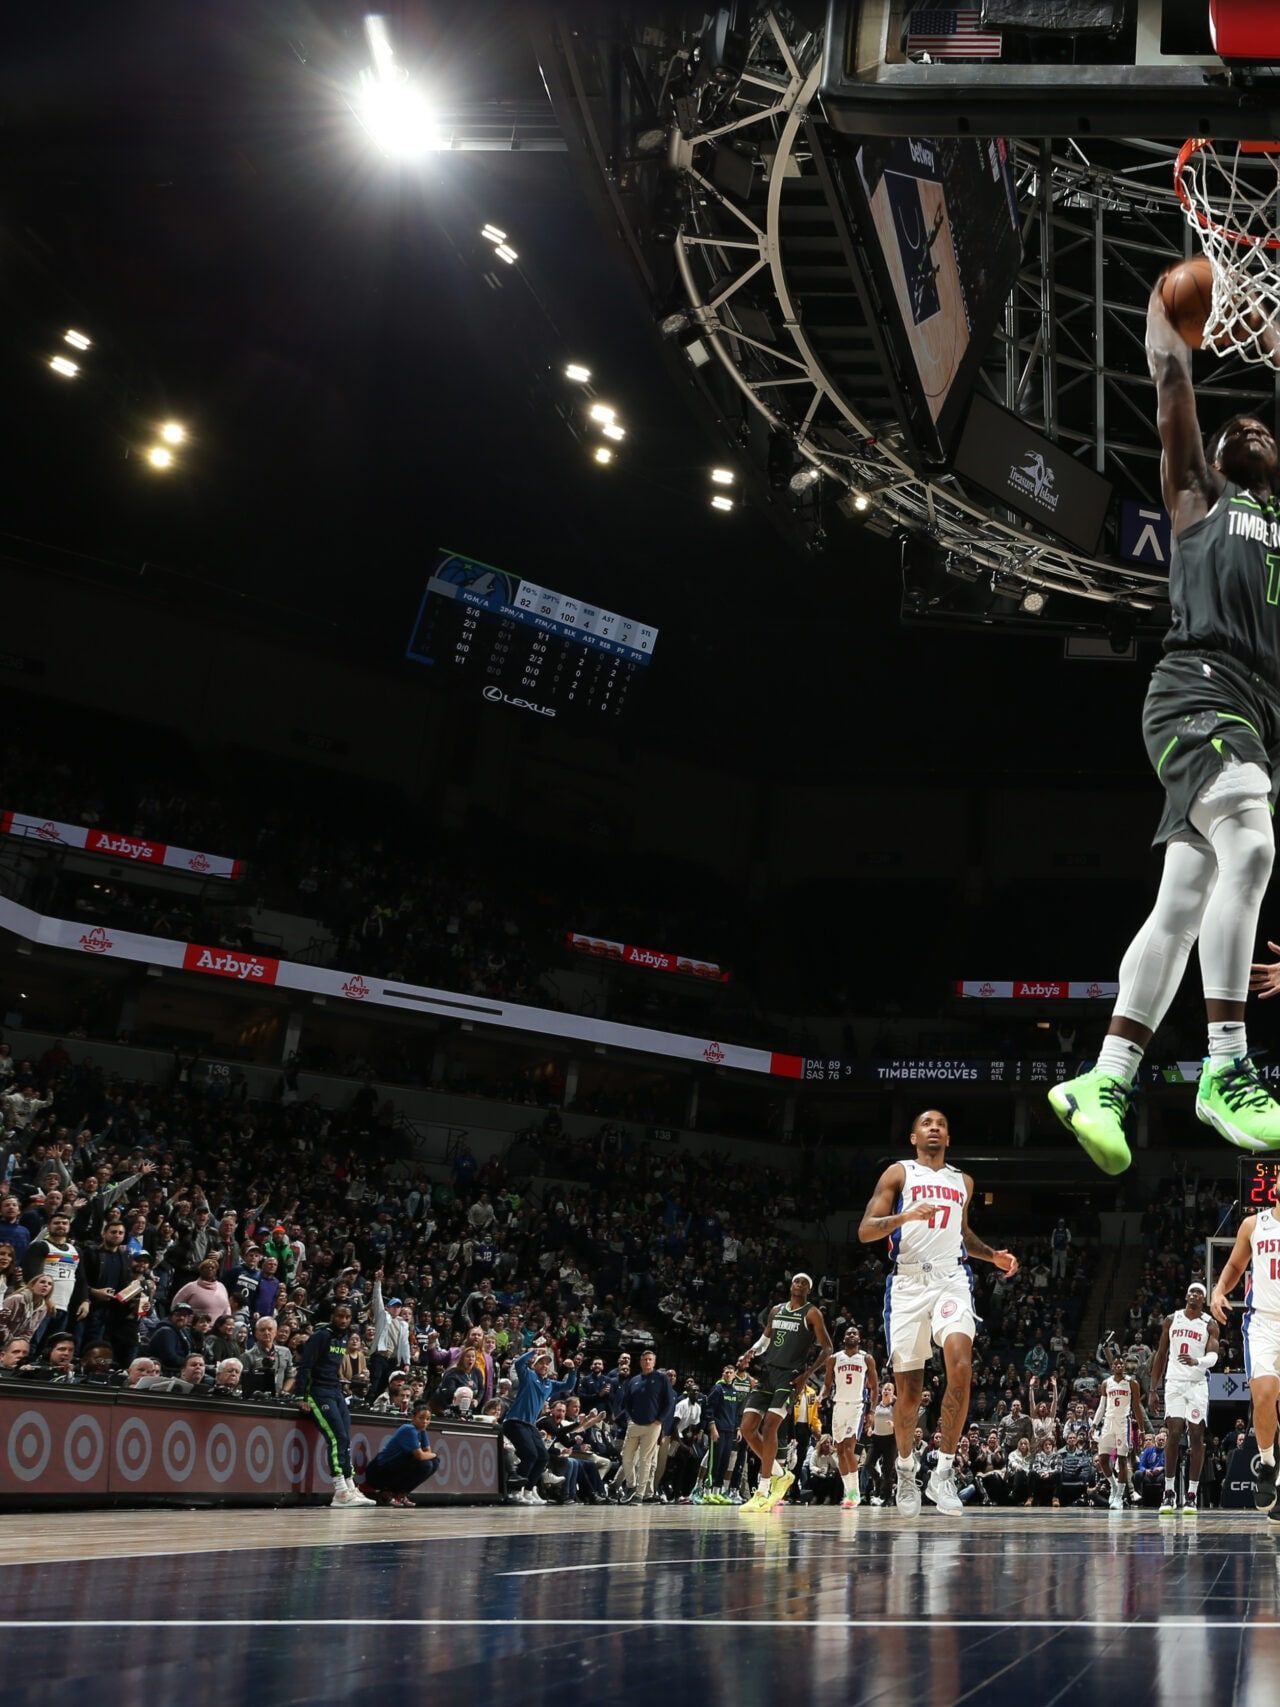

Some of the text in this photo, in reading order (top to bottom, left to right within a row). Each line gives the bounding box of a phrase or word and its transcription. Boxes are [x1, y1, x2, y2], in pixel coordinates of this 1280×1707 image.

[503, 695, 557, 717] LEXUS
[97, 834, 152, 858] Arby's
[197, 950, 264, 978] Arby's
[630, 949, 668, 968] Arby's
[1020, 983, 1060, 998] Arby's
[208, 1065, 230, 1076] 136
[806, 1060, 841, 1070] DAL 89
[845, 1066, 851, 1075] 3
[806, 1071, 840, 1079] SAS 76
[877, 1068, 977, 1079] TIMBERWOLVES
[655, 1130, 671, 1140] 138
[911, 1185, 964, 1207] PISTONS
[774, 1331, 787, 1346] 3
[1172, 1329, 1202, 1341] PISTONS
[838, 1365, 862, 1373] PISTONS
[846, 1374, 852, 1384] 5
[1115, 1398, 1120, 1407] 6
